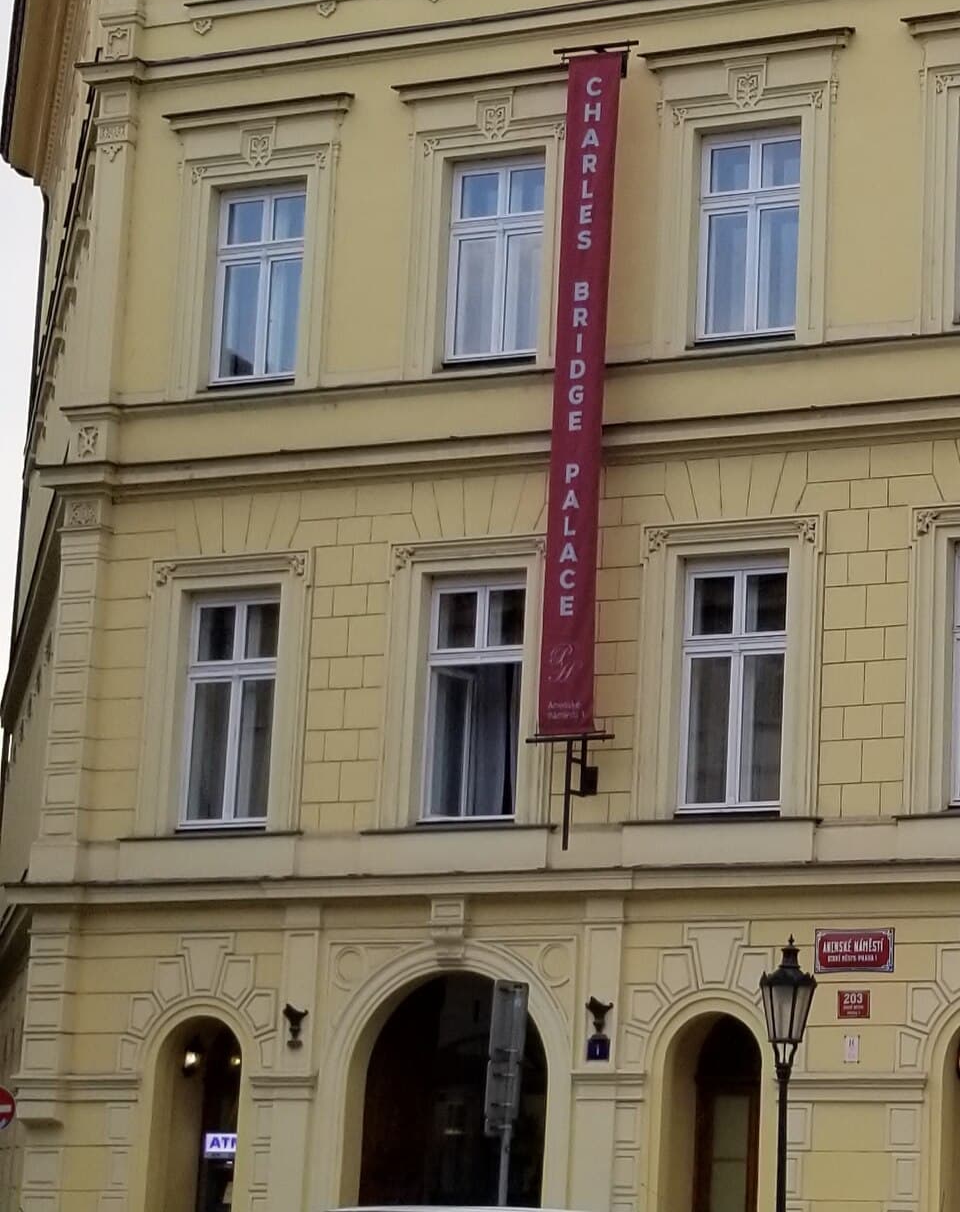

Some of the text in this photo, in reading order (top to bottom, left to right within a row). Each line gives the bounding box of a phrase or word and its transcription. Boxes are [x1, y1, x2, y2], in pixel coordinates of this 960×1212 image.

[559, 76, 602, 617] CHARLES BRIDGE PALACE
[823, 937, 884, 953] ANENSKÉ NÁMĚSTÍ
[843, 993, 863, 1005] 203
